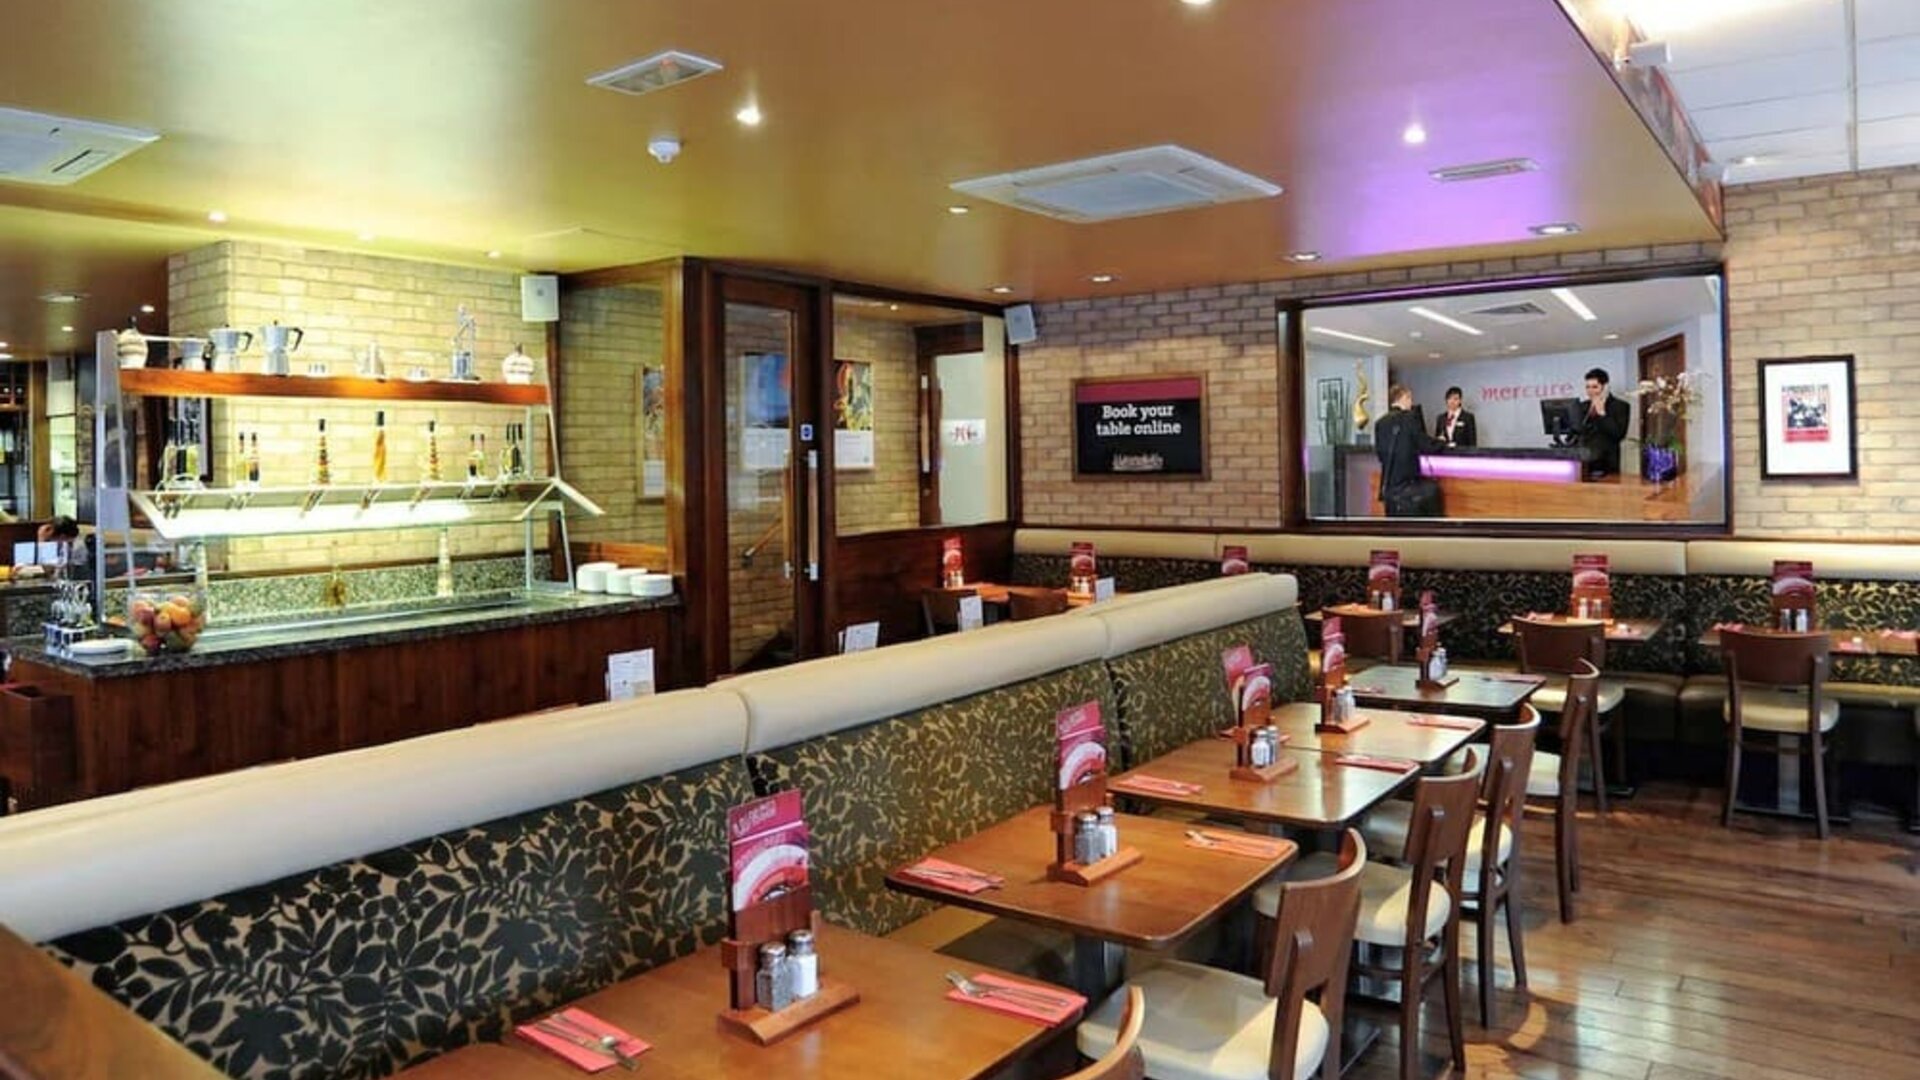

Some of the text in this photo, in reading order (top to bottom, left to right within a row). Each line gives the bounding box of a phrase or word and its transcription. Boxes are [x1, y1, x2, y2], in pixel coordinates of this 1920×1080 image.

[1481, 383, 1573, 401] mercure
[1102, 404, 1174, 421] Book your
[1096, 420, 1181, 435] table online
